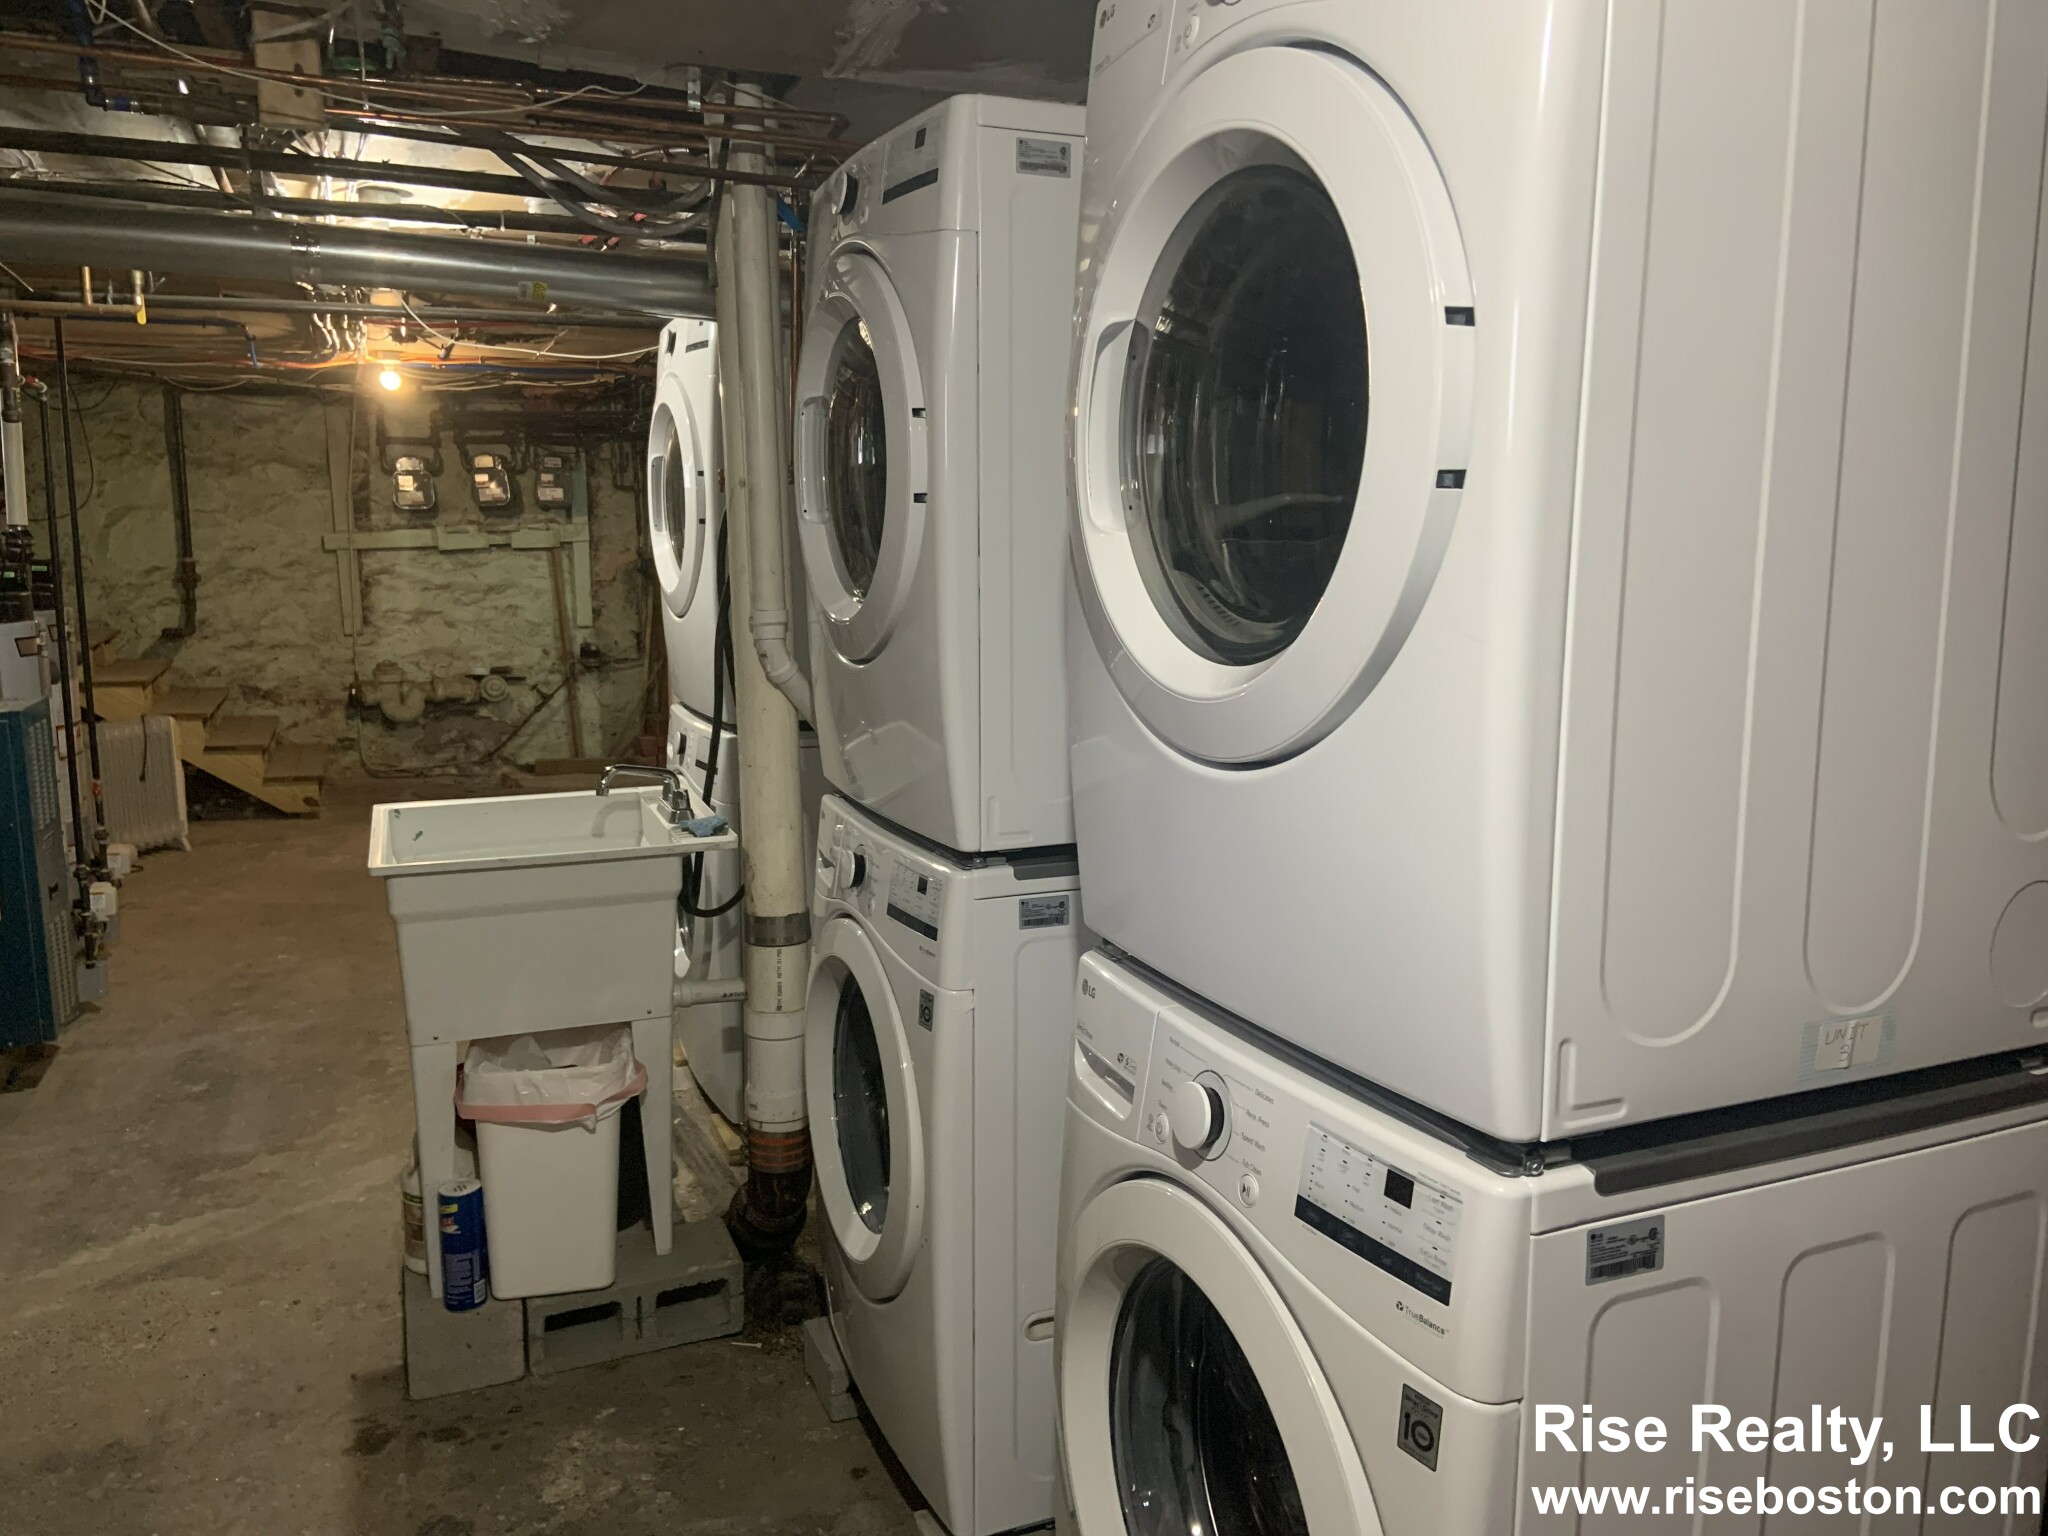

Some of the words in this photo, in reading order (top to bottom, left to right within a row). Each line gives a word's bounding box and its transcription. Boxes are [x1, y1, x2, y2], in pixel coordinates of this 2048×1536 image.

[1825, 1022, 1870, 1046] UNIT
[1254, 1088, 1274, 1105] Delicates
[1241, 1132, 1253, 1145] Speed
[1254, 1140, 1266, 1152] Wash
